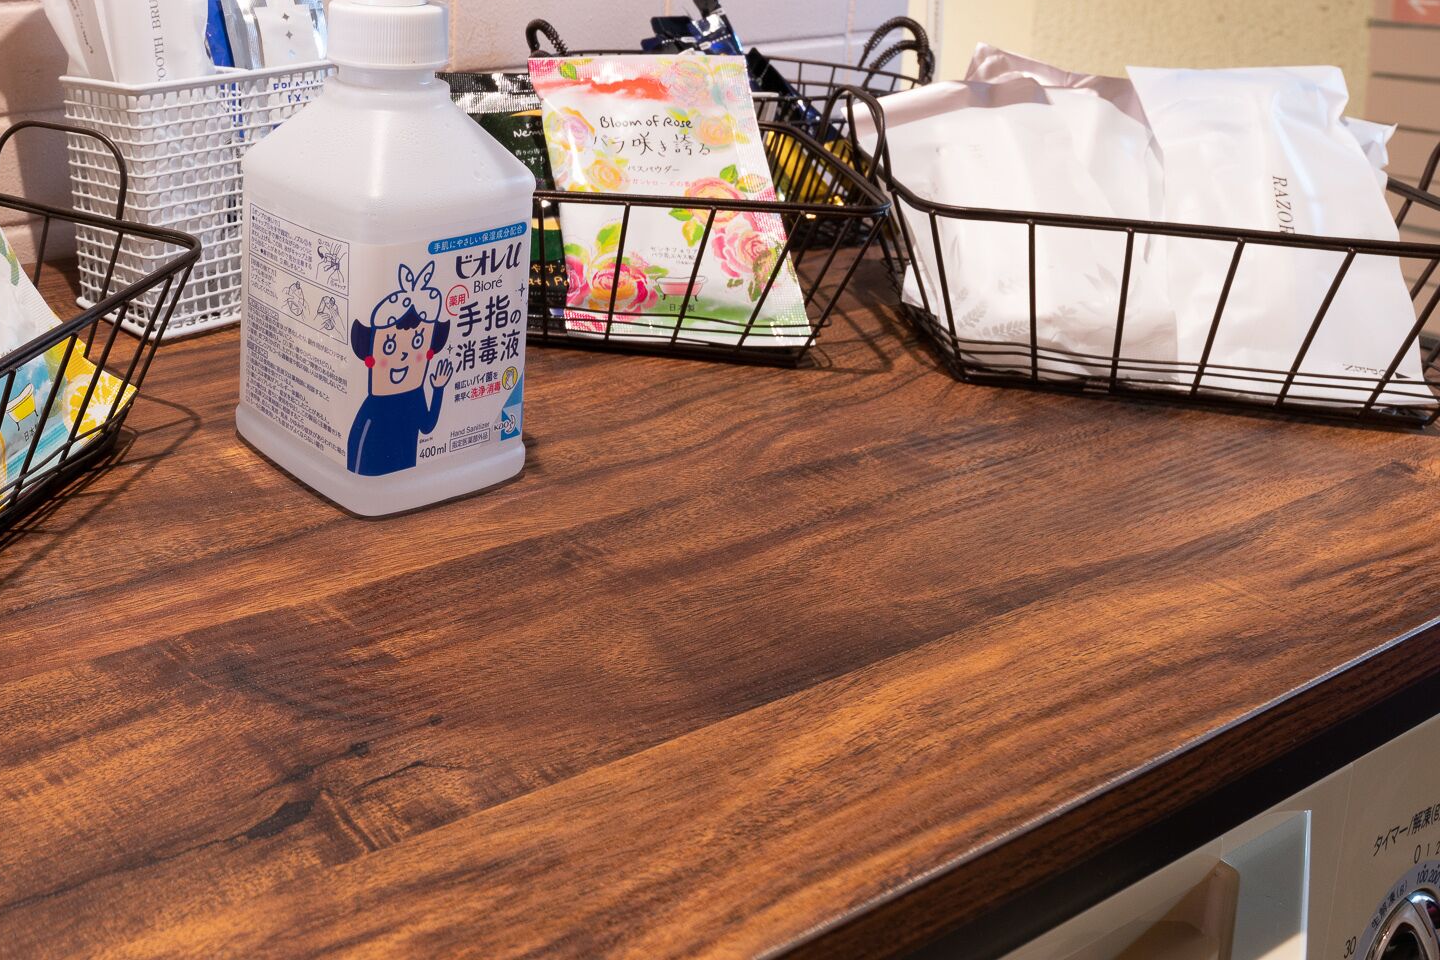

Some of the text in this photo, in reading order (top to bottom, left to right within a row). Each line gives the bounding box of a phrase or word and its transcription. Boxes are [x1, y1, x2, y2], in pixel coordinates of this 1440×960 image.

[153, 34, 167, 82] OOTH
[600, 115, 693, 129] Bloom of Rose
[433, 224, 524, 253] 手肌にやさしい保湿成分配合
[473, 274, 503, 294] Bioré
[449, 293, 466, 308] 薬用
[456, 295, 522, 337] 手指の
[455, 329, 521, 373] 消毒液
[1414, 844, 1422, 864] 0
[1343, 935, 1357, 960] 30
